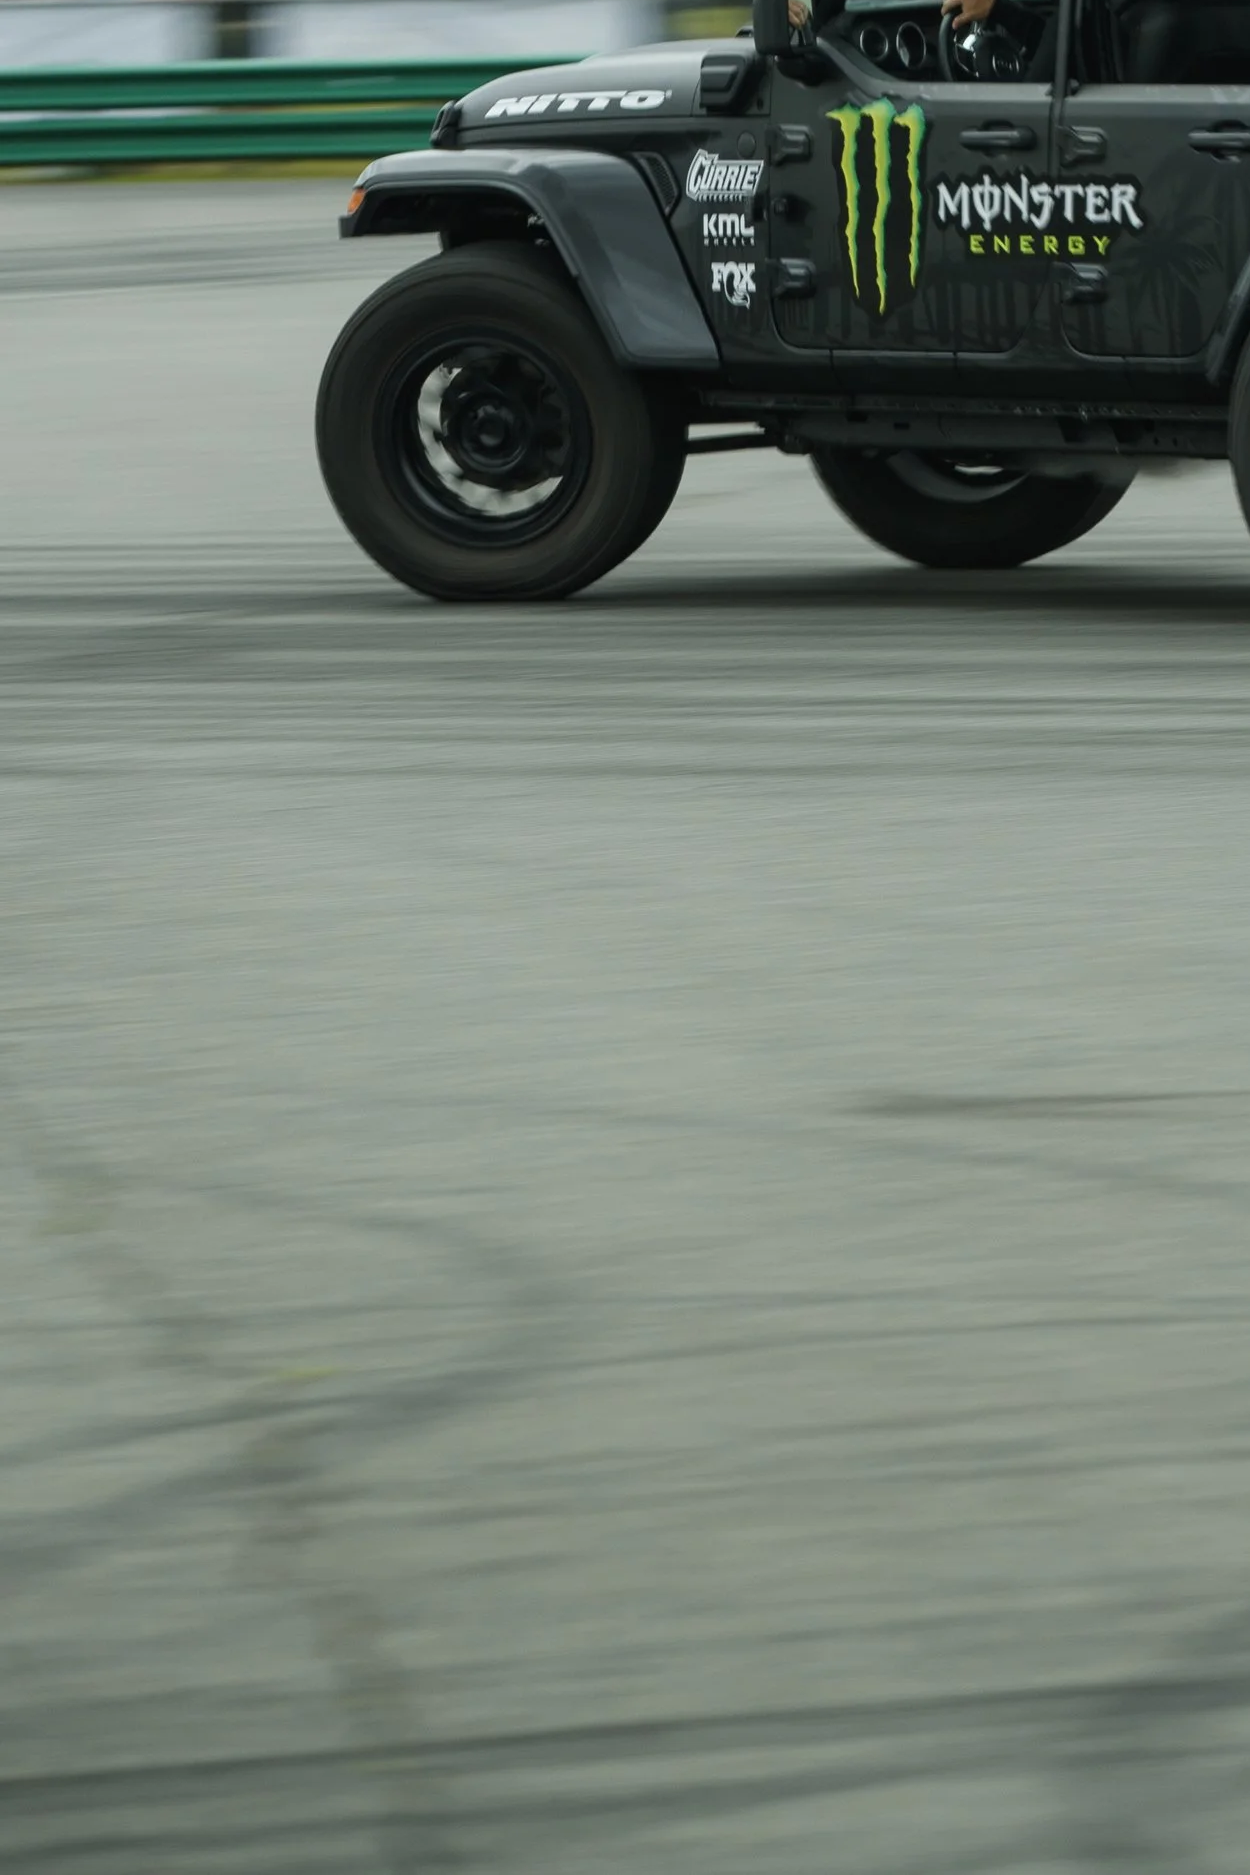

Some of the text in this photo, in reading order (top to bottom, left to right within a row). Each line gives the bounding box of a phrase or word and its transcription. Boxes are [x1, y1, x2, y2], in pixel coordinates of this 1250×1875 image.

[484, 89, 668, 119] NITTO
[687, 149, 764, 197] CURRIE
[936, 173, 1144, 231] MONSTER
[969, 234, 1111, 256] ENERGY
[711, 260, 757, 307] FOX
